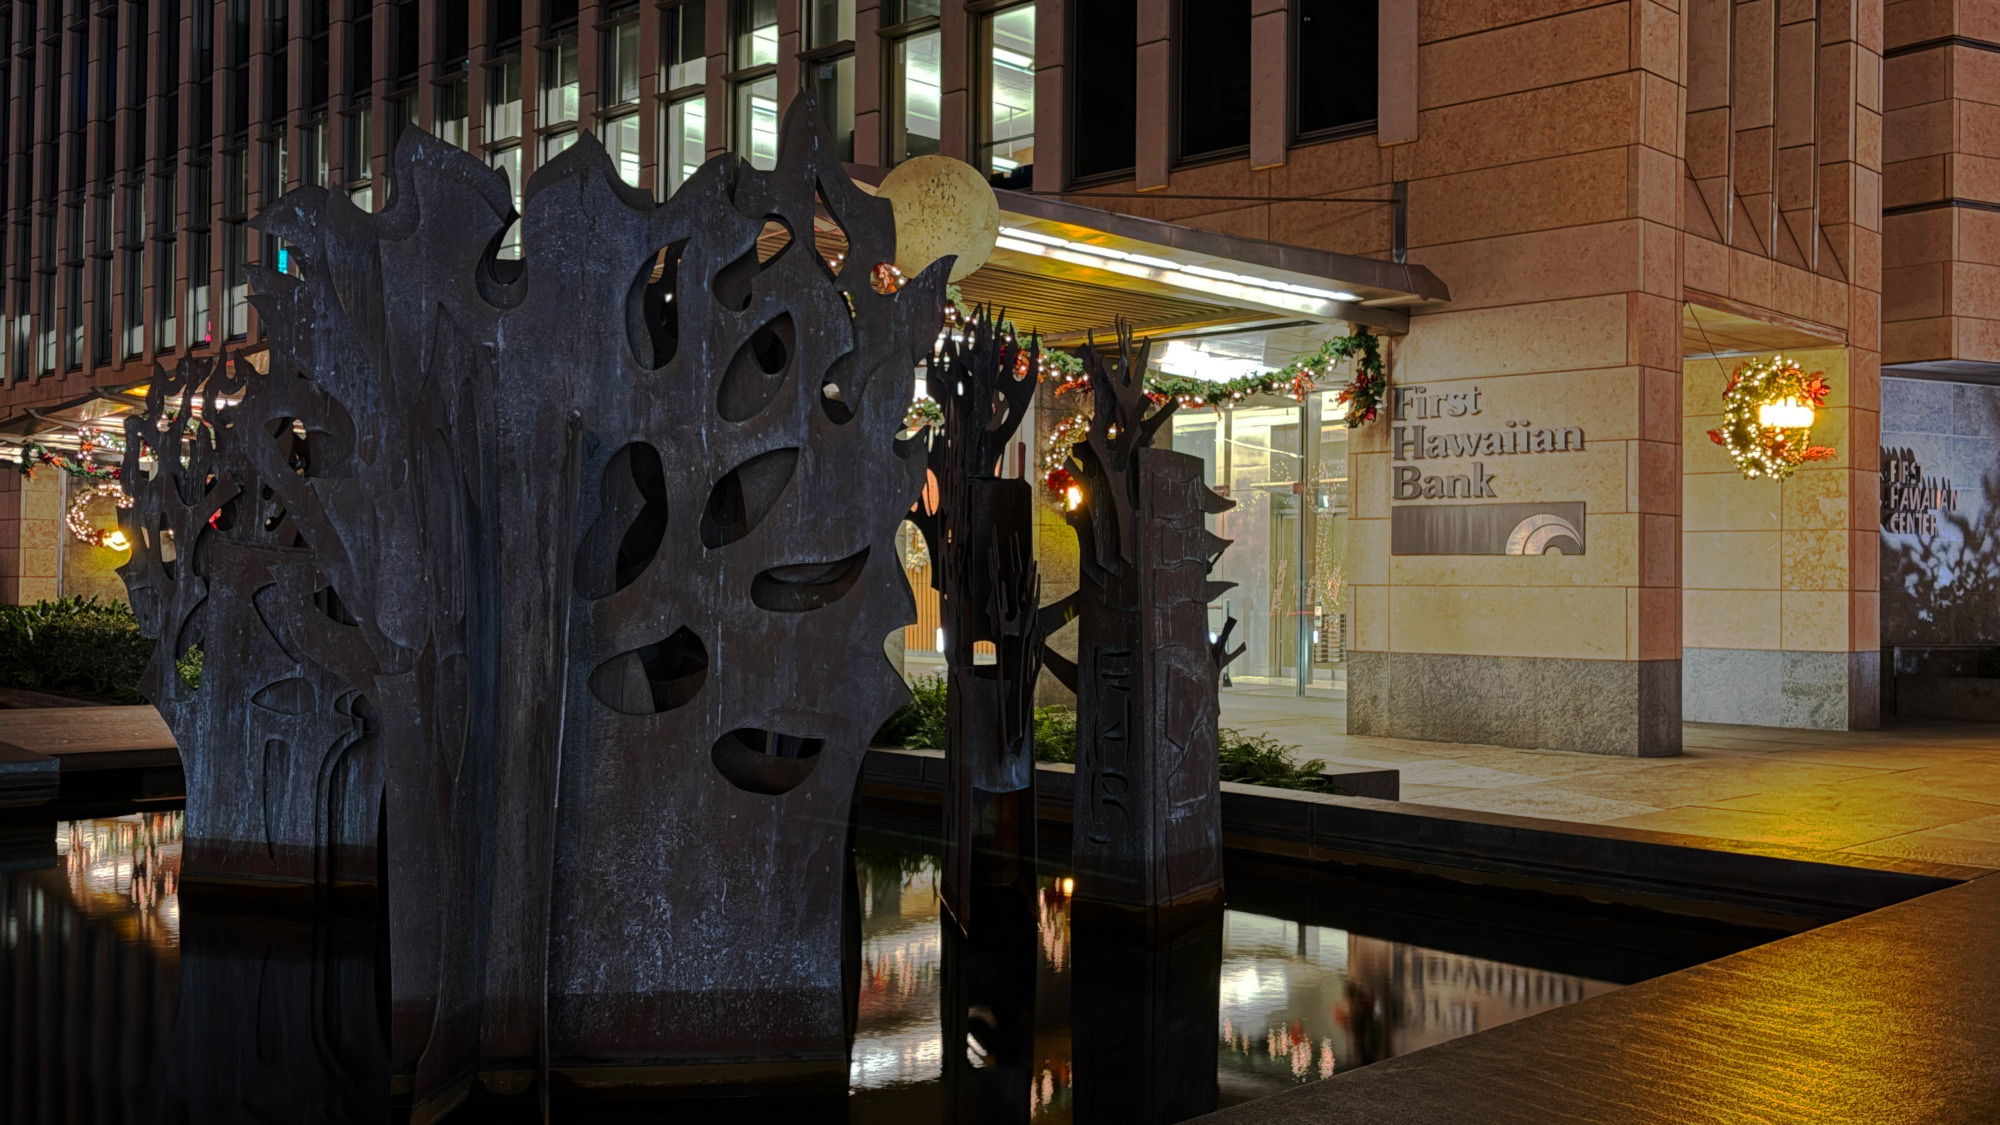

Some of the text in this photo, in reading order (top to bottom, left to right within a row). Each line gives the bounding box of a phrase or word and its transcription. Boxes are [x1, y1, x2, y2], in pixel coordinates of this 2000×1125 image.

[1391, 385, 1483, 421] First
[1392, 419, 1586, 461] Hawaiian
[1392, 461, 1498, 500] Bank
[1890, 460, 1922, 485] FIRST
[1890, 486, 1958, 512] HAWAIIAN
[1890, 512, 1938, 537] CENTER
